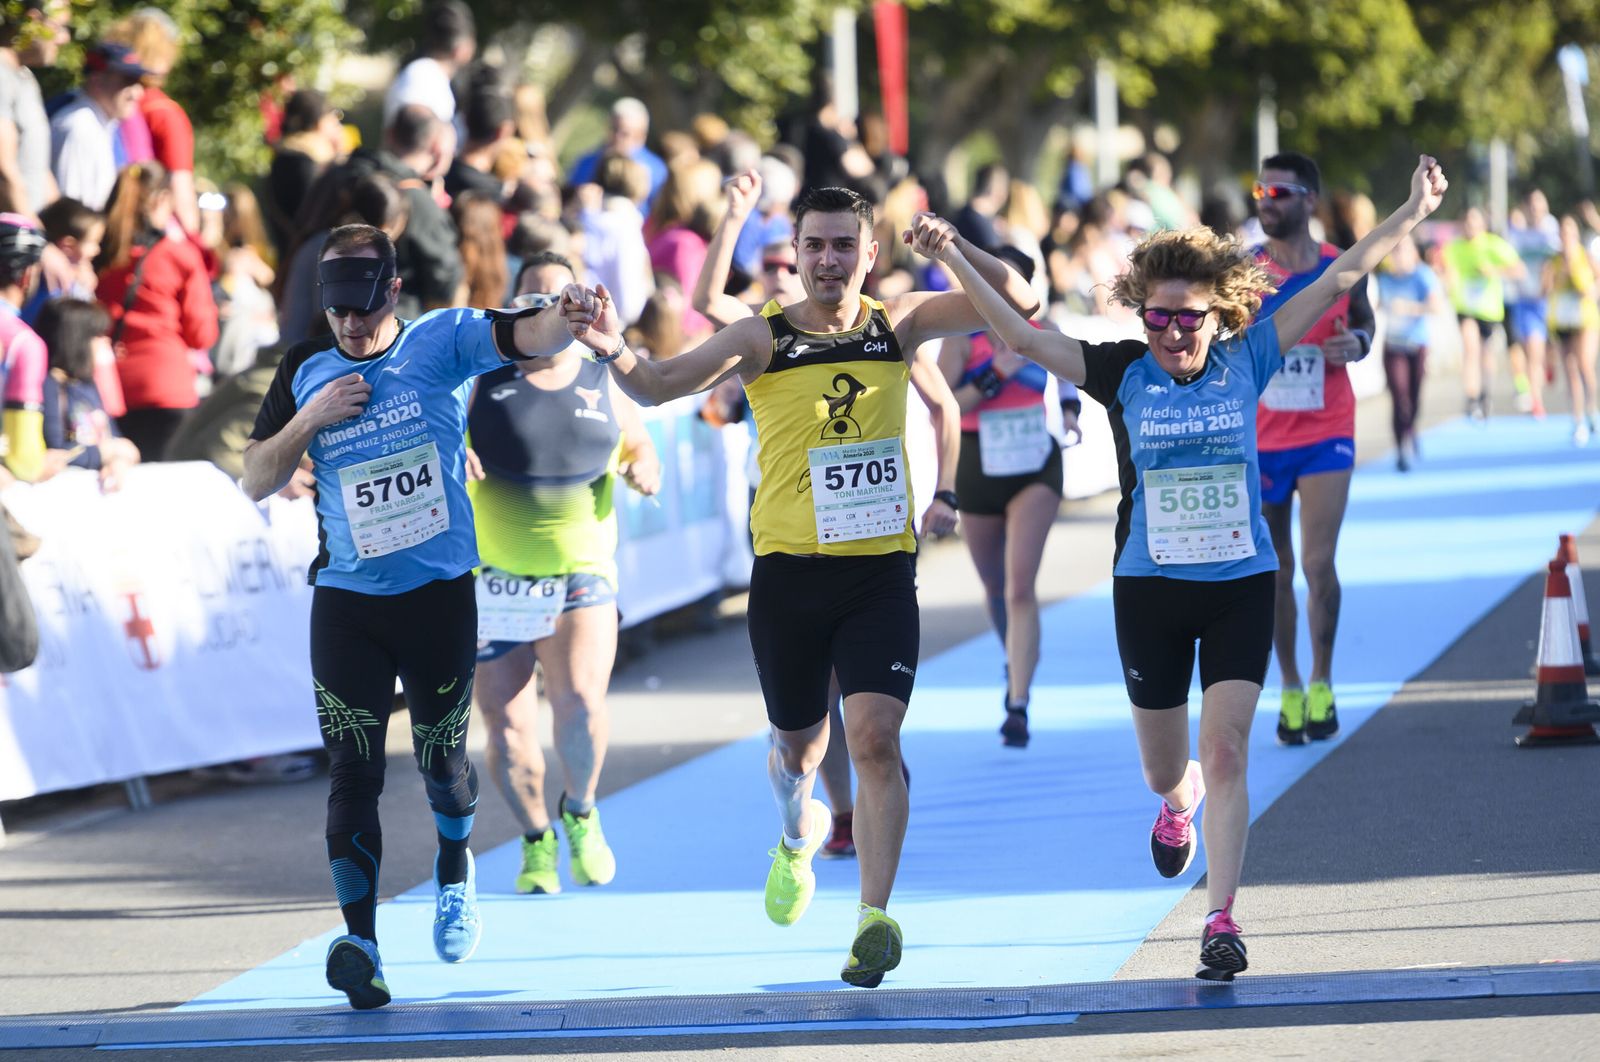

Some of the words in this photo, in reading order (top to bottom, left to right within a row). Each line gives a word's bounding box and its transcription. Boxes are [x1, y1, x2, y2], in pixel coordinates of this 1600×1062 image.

[1281, 357, 1316, 374] 47
[361, 390, 419, 417] Maratón
[1140, 406, 1182, 418] Medio
[318, 419, 377, 448] Almería
[376, 401, 423, 429] 2020
[355, 436, 380, 449] RUIZ
[382, 420, 428, 443] ANDÚJAR
[1140, 419, 1204, 436] Almería
[1206, 411, 1244, 432] 2020
[381, 444, 389, 455] 2
[390, 432, 429, 452] febrero
[1140, 439, 1175, 450] RAMÓN
[1178, 437, 1203, 447] RUIZ
[1206, 432, 1246, 445] ANDÚJ
[1201, 446, 1210, 456] 2
[354, 463, 433, 508] 5704
[825, 457, 898, 491] 5705
[370, 502, 393, 515] FRAN
[394, 492, 425, 506] VARGAS
[834, 490, 855, 499] TONI
[1160, 483, 1239, 513] 5685
